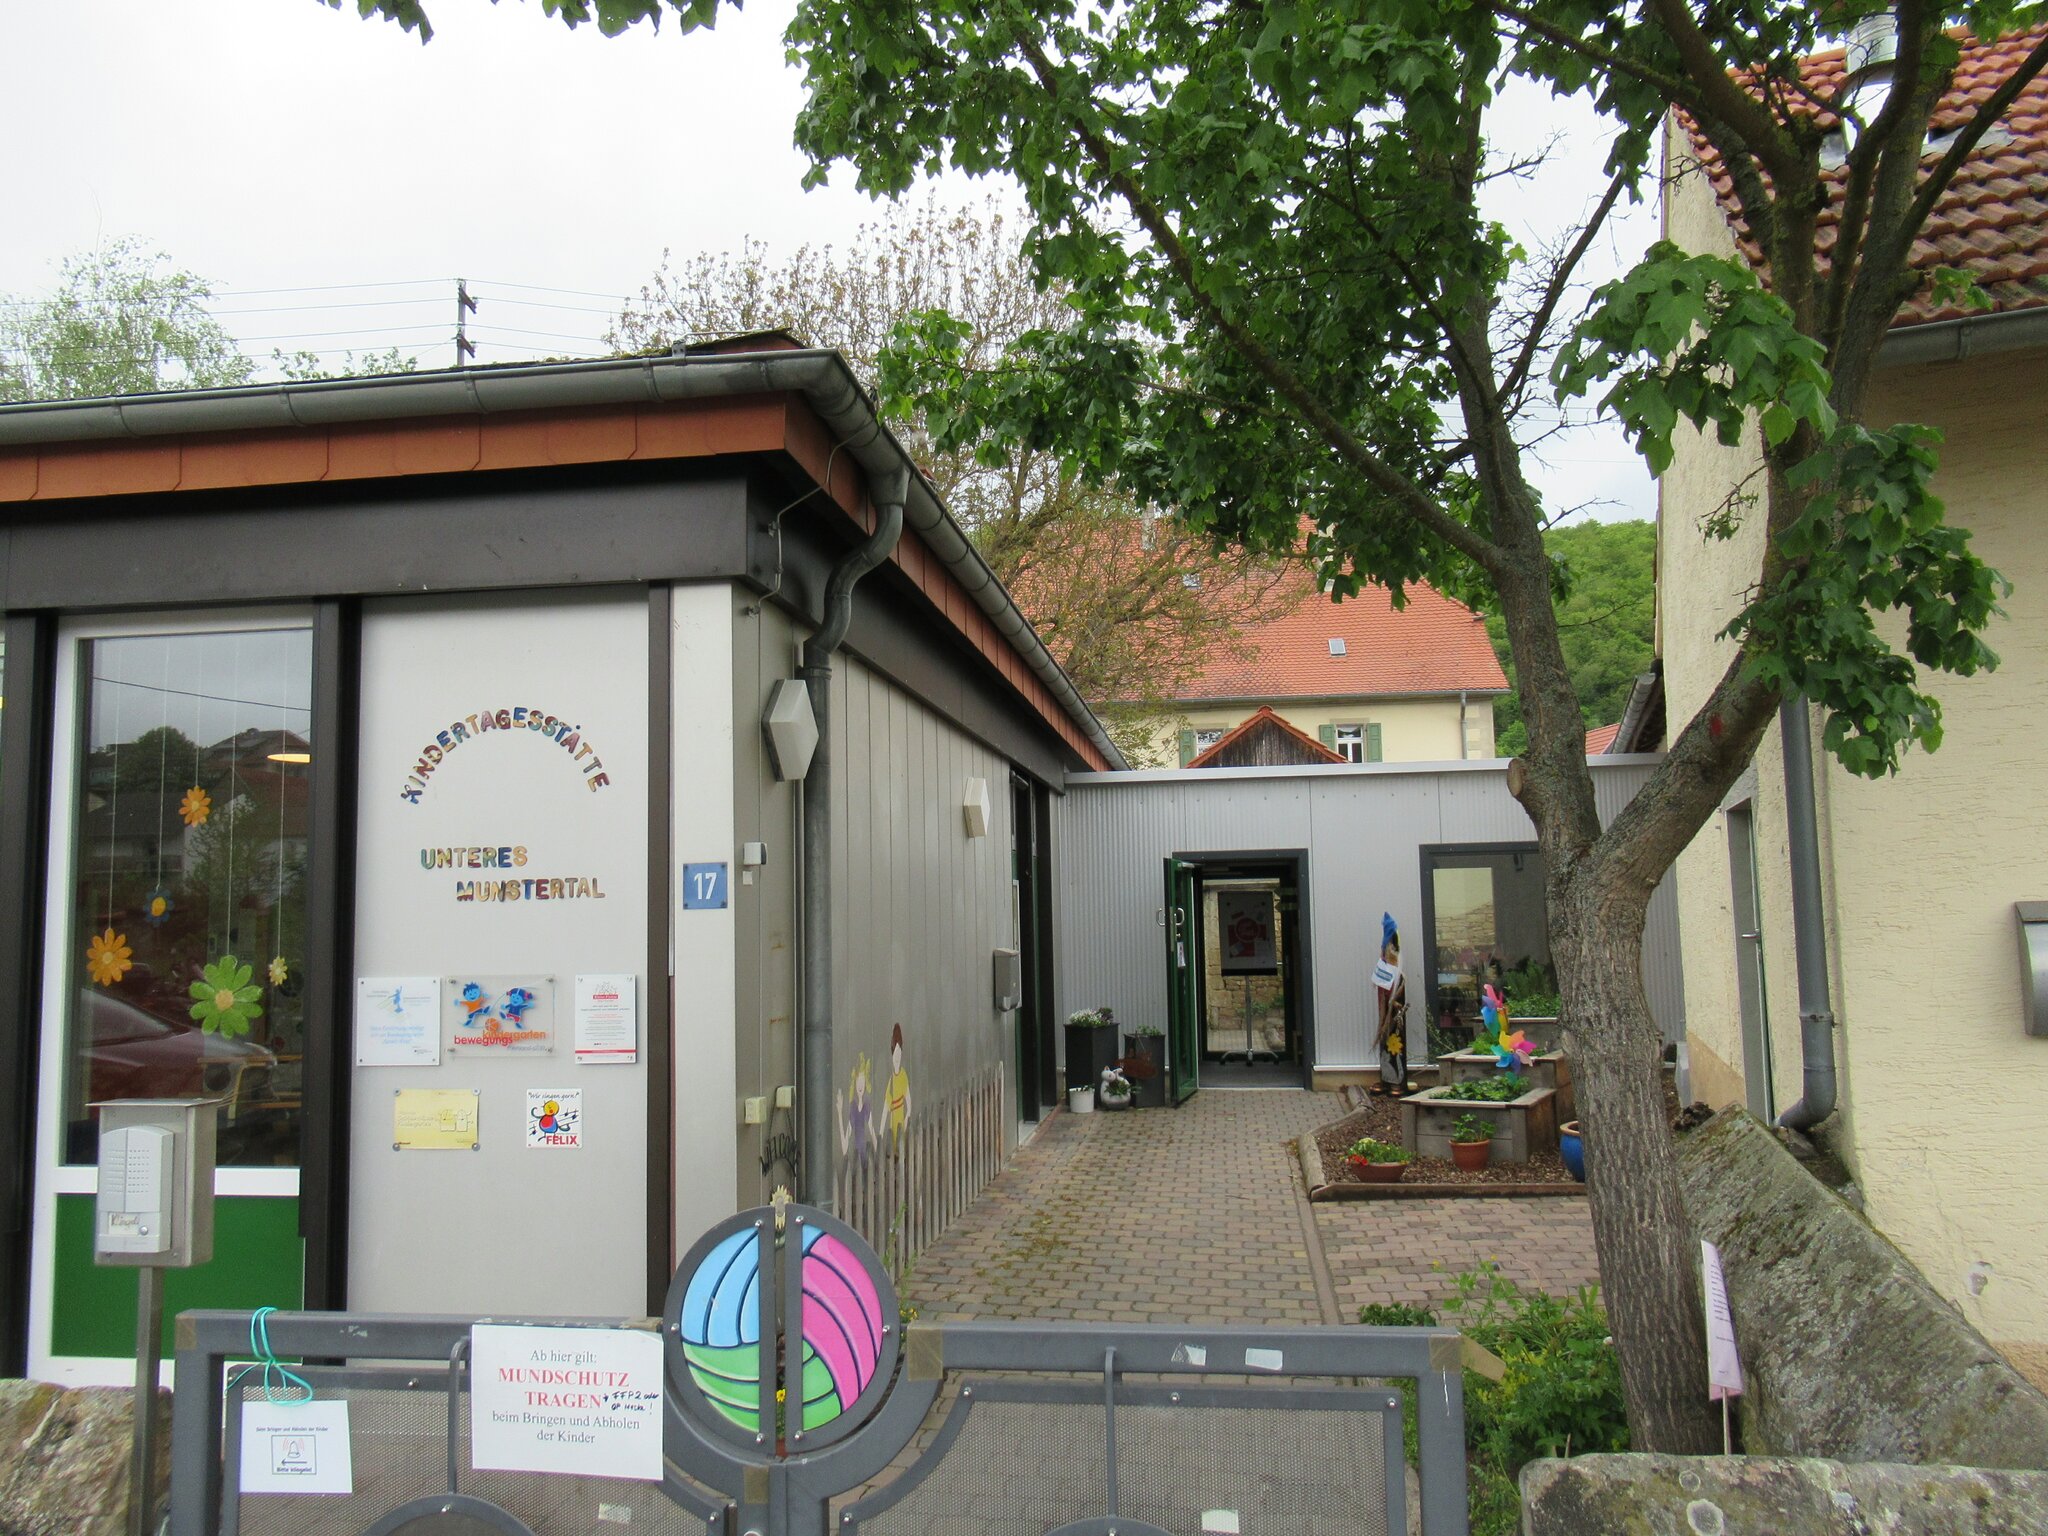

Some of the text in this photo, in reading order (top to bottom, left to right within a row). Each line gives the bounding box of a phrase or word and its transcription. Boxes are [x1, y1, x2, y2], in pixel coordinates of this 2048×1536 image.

[401, 707, 610, 805] KINDERTAGESSTÄTTE
[420, 845, 528, 870] UNTERES
[693, 872, 717, 900] 17
[454, 1035, 513, 1046] bewegungs
[546, 1136, 577, 1145] FELIX
[530, 1350, 597, 1365] Ab hier gilt:
[498, 1368, 630, 1387] MUNDSCHUTZ
[525, 1391, 602, 1408] TRAGEN
[492, 1412, 640, 1430] beim Bringen und Abholen
[537, 1430, 596, 1444] der Kinder
